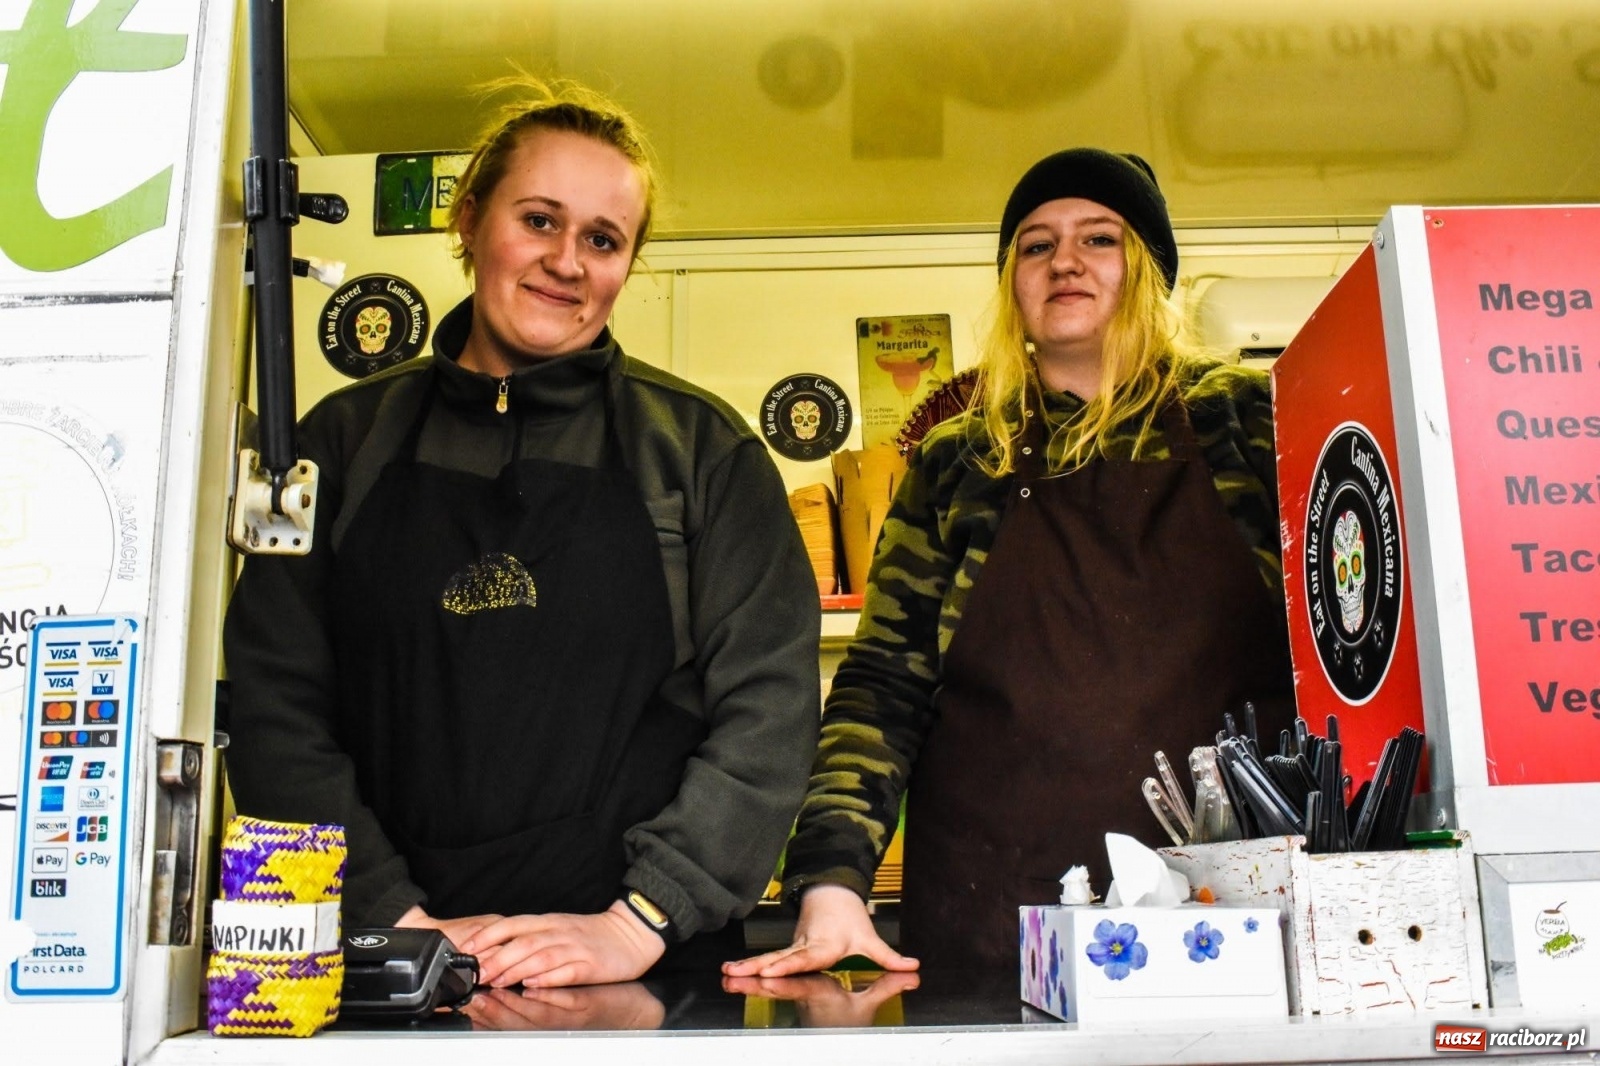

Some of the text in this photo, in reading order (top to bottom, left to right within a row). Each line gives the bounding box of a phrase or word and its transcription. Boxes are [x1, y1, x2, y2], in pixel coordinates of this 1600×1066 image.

[387, 280, 425, 344] Cantina Mexicana
[1478, 283, 1593, 317] Mega
[326, 284, 362, 350] Eat on the Street
[877, 339, 928, 351] Margarita
[1487, 345, 1583, 374] Chili
[766, 382, 794, 436] Eat on the Street
[814, 379, 848, 433] Cantina Mexicana
[1496, 410, 1600, 440] Ques
[1351, 435, 1396, 598] Cantina Mexicana
[1307, 468, 1331, 639] Eat on the Street
[1511, 543, 1600, 573] Tac
[1519, 612, 1600, 642] Tre
[50, 649, 77, 659] VISA
[91, 647, 119, 657] VISA
[48, 677, 74, 688] VISA
[97, 673, 109, 684] V
[36, 822, 67, 830] DISCOVER
[45, 855, 63, 867] Pay
[90, 852, 111, 868] Pay
[35, 881, 61, 896] blik
[213, 925, 305, 952] NAPIWKI
[23, 965, 84, 973] POLCARD
